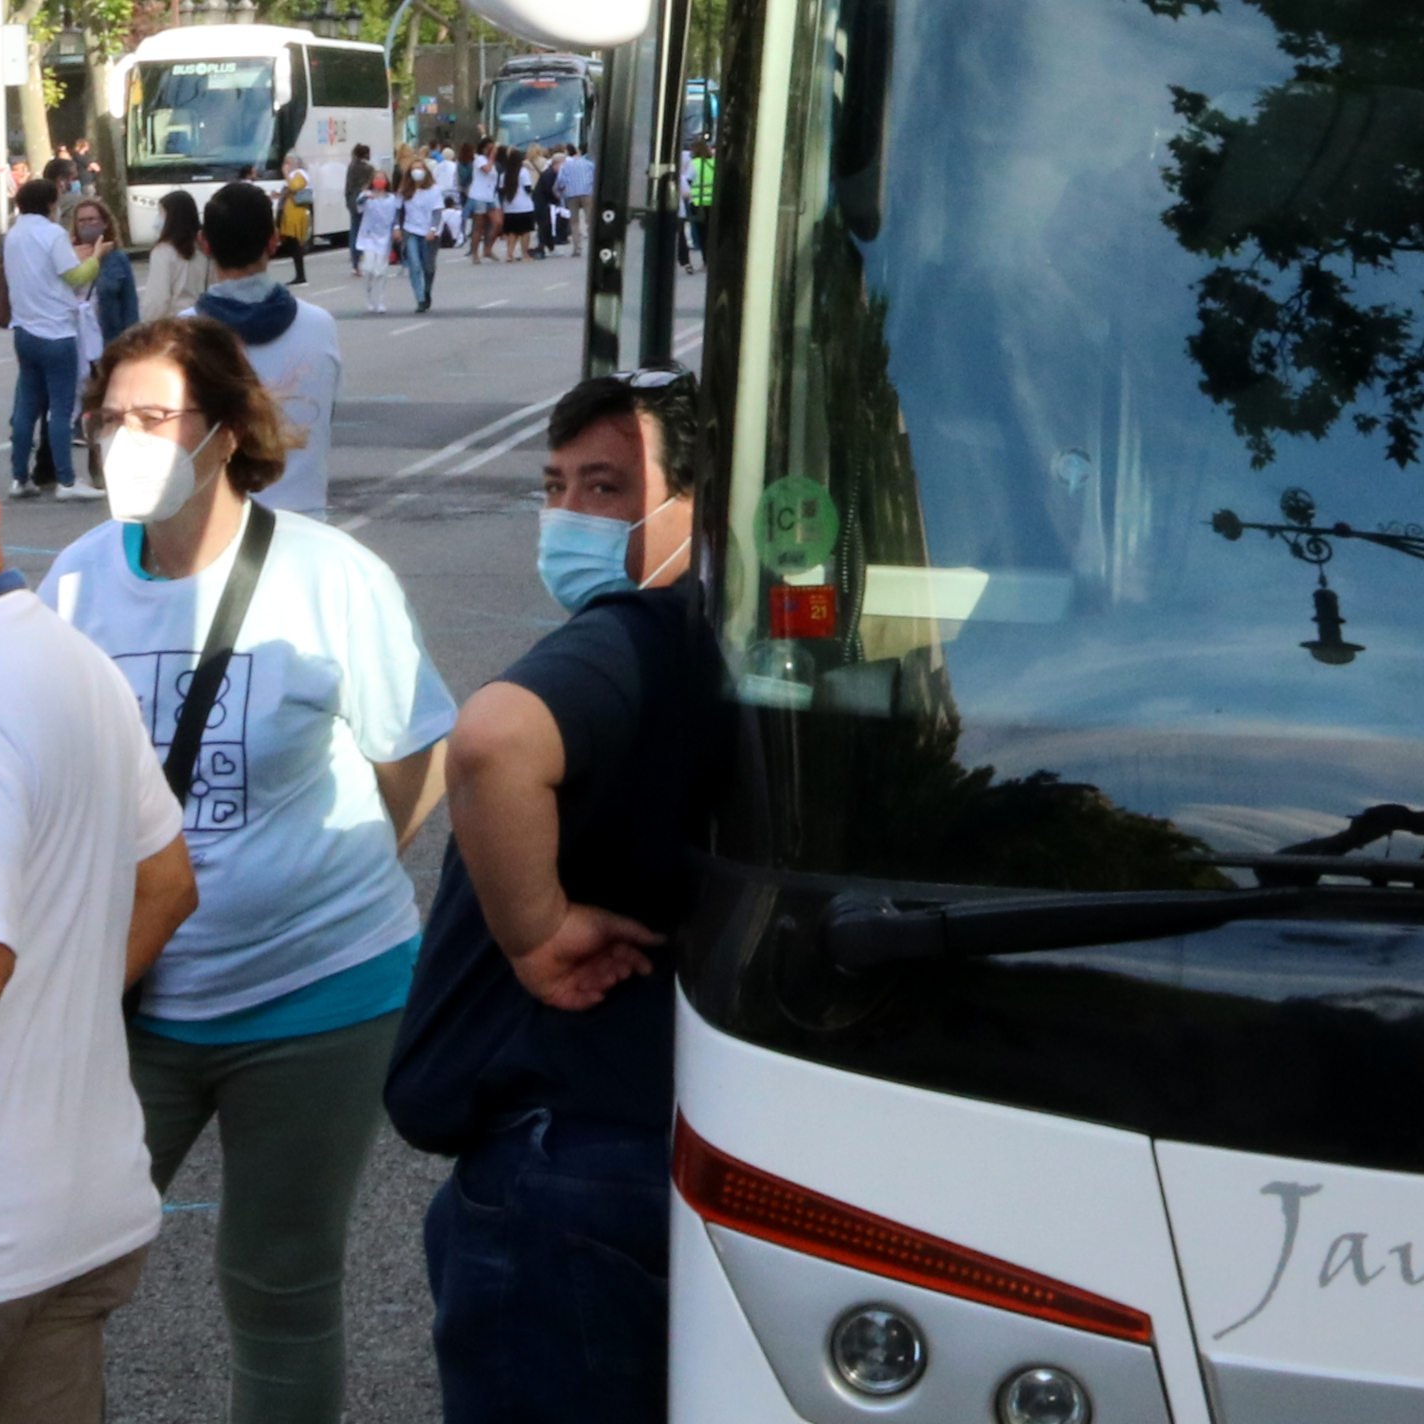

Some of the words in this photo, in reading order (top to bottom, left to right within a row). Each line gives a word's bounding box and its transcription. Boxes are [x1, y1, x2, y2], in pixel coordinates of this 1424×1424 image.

[172, 64, 195, 76] BUS
[208, 62, 236, 73] PLUS
[810, 605, 828, 620] 21
